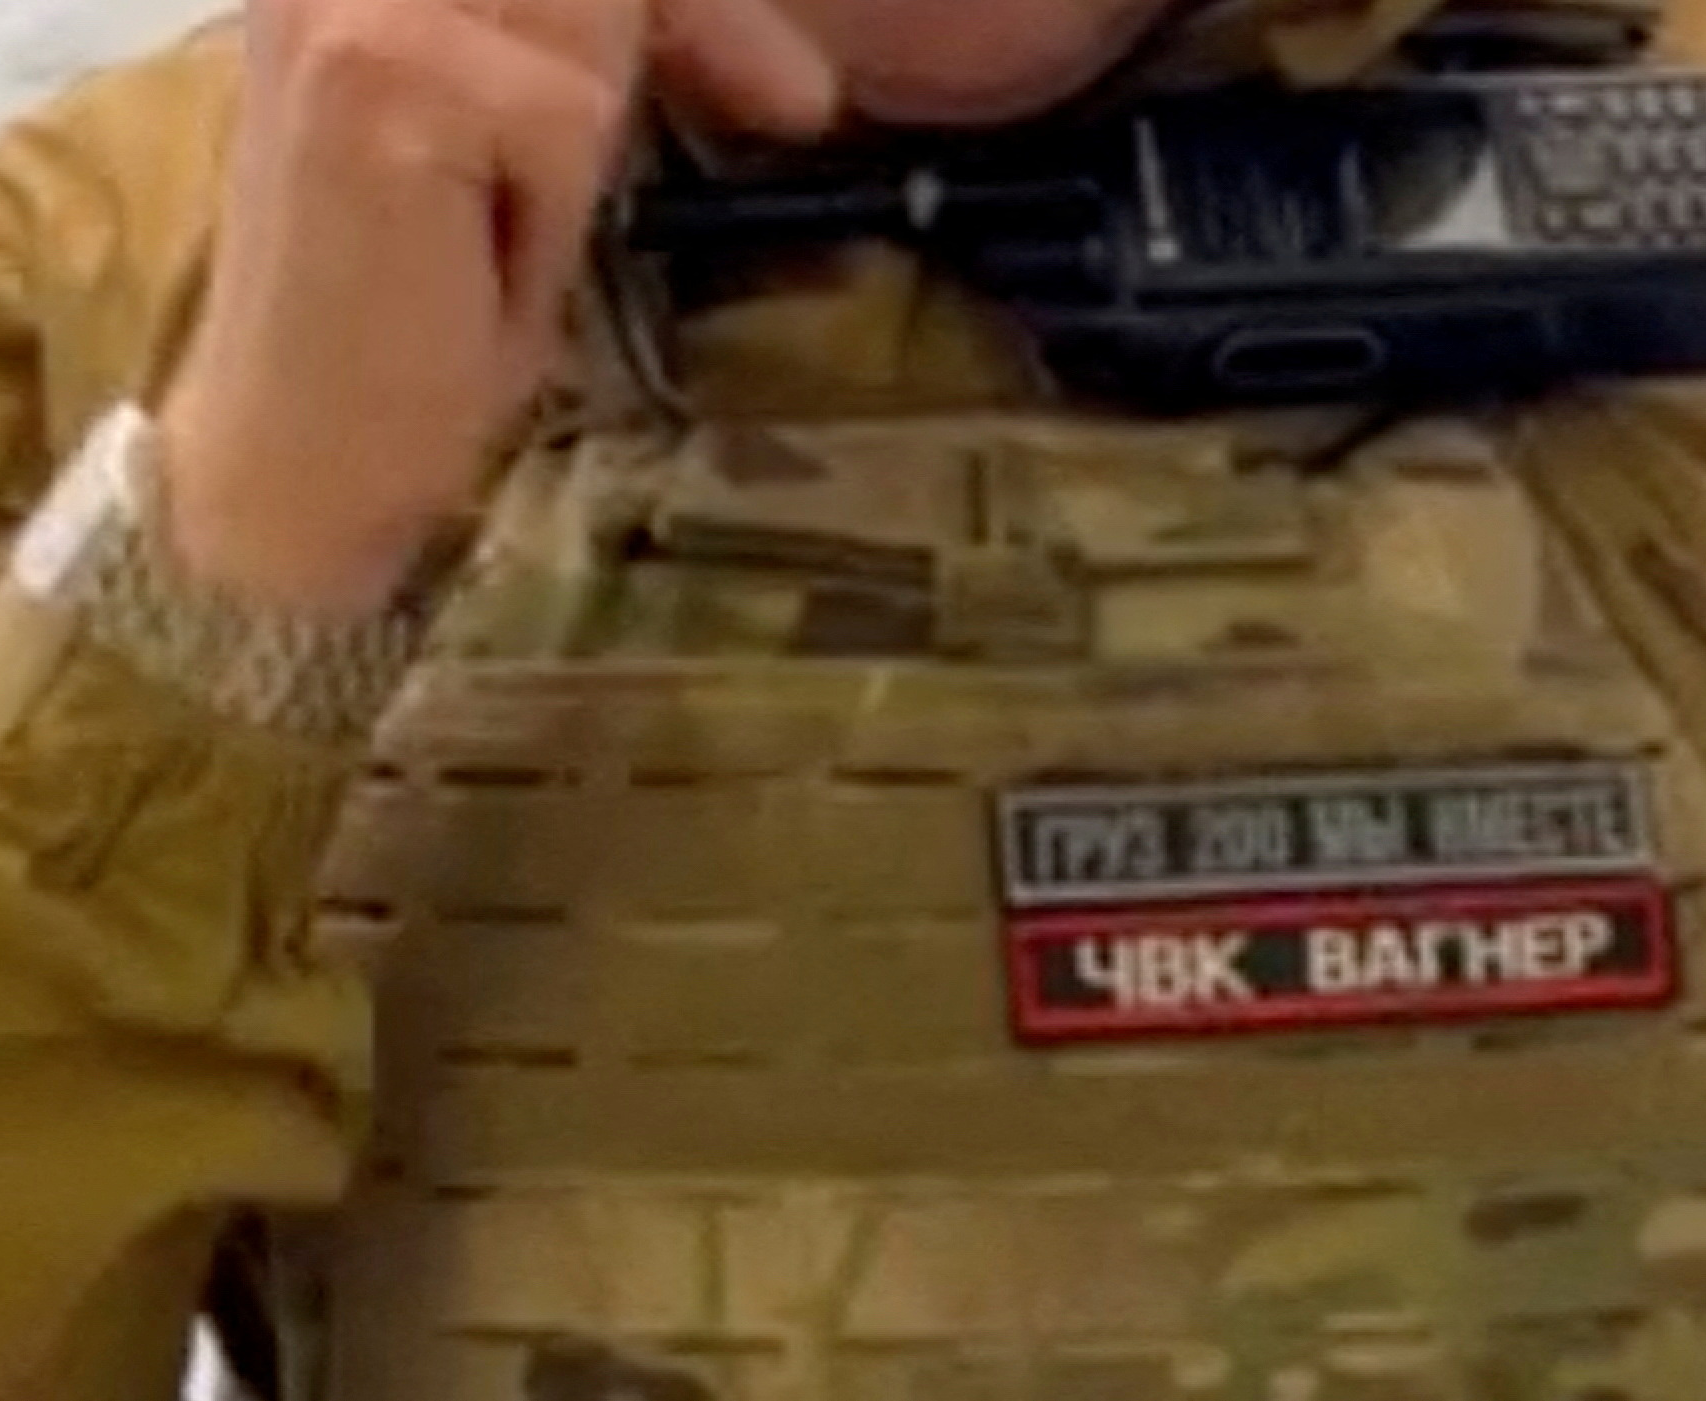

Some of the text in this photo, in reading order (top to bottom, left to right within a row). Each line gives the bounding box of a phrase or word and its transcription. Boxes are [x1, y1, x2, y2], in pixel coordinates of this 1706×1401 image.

[1037, 808, 1168, 882] ГРУЗ
[1191, 800, 1290, 870] 200
[1073, 912, 1613, 1012] ЧВК ВАГНЕР
